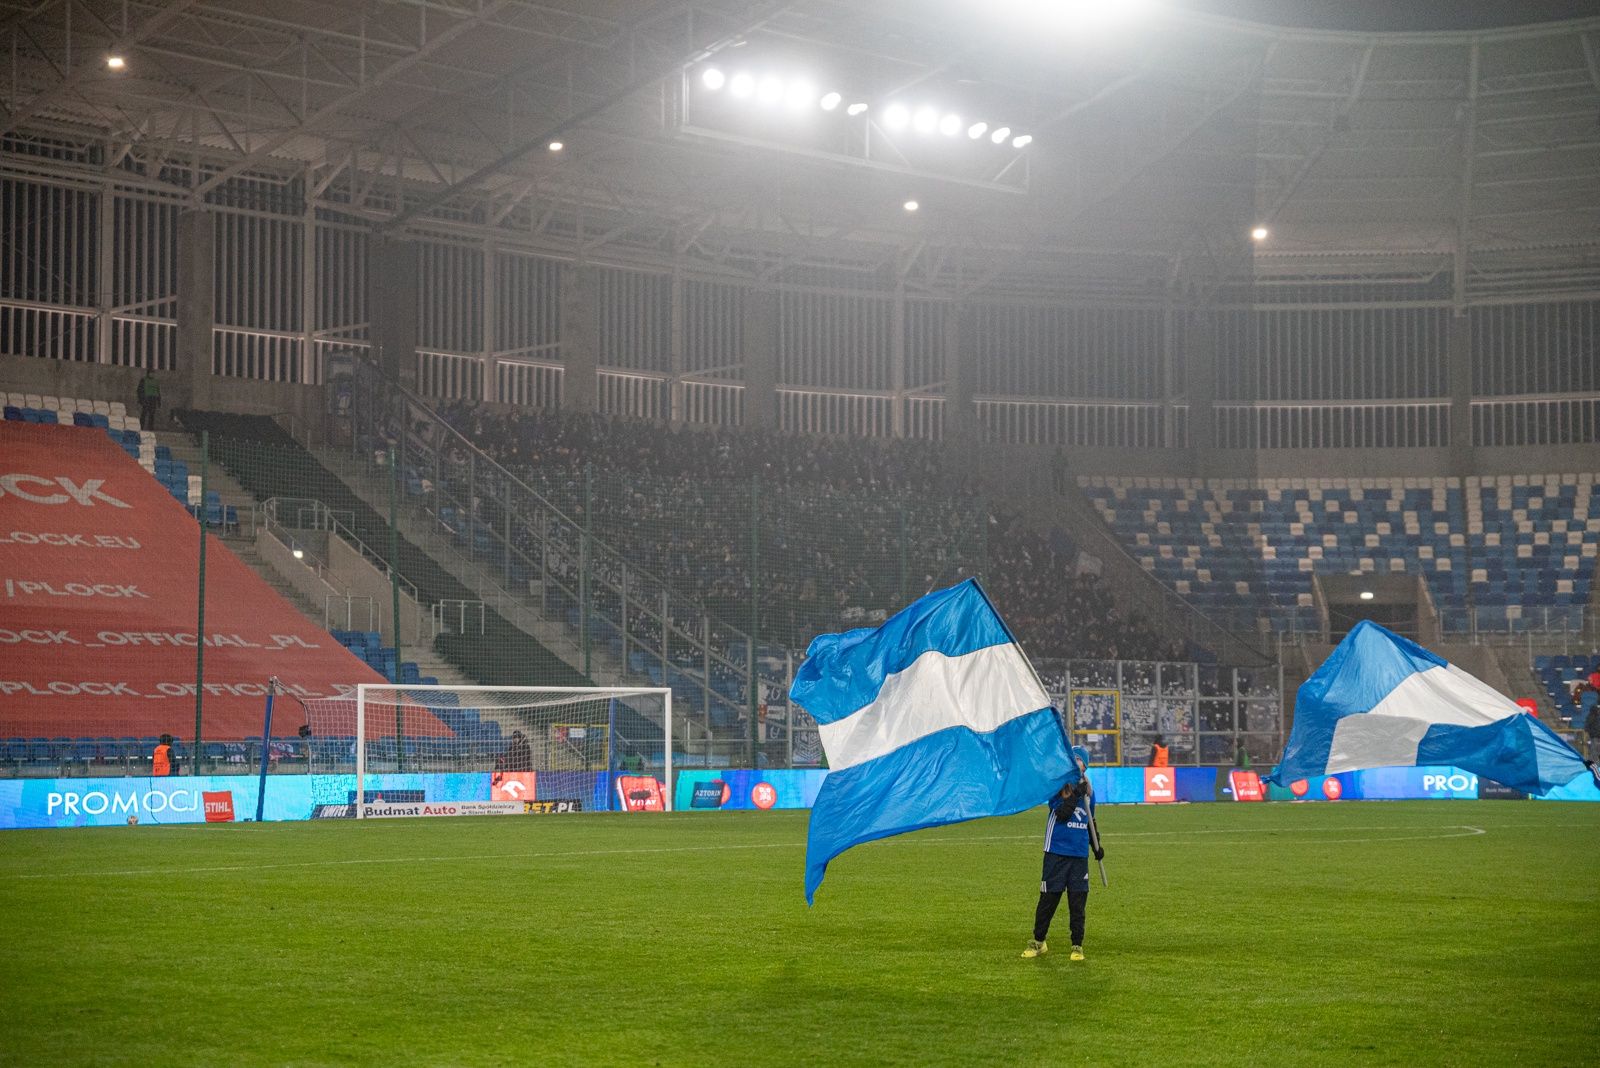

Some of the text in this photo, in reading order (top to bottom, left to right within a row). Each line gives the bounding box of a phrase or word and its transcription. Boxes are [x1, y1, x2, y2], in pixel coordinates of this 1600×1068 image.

[0, 474, 133, 508] CK
[205, 801, 231, 813] STIHL
[365, 806, 457, 816] Budmat Auto
[1066, 821, 1088, 829] ORLEN
